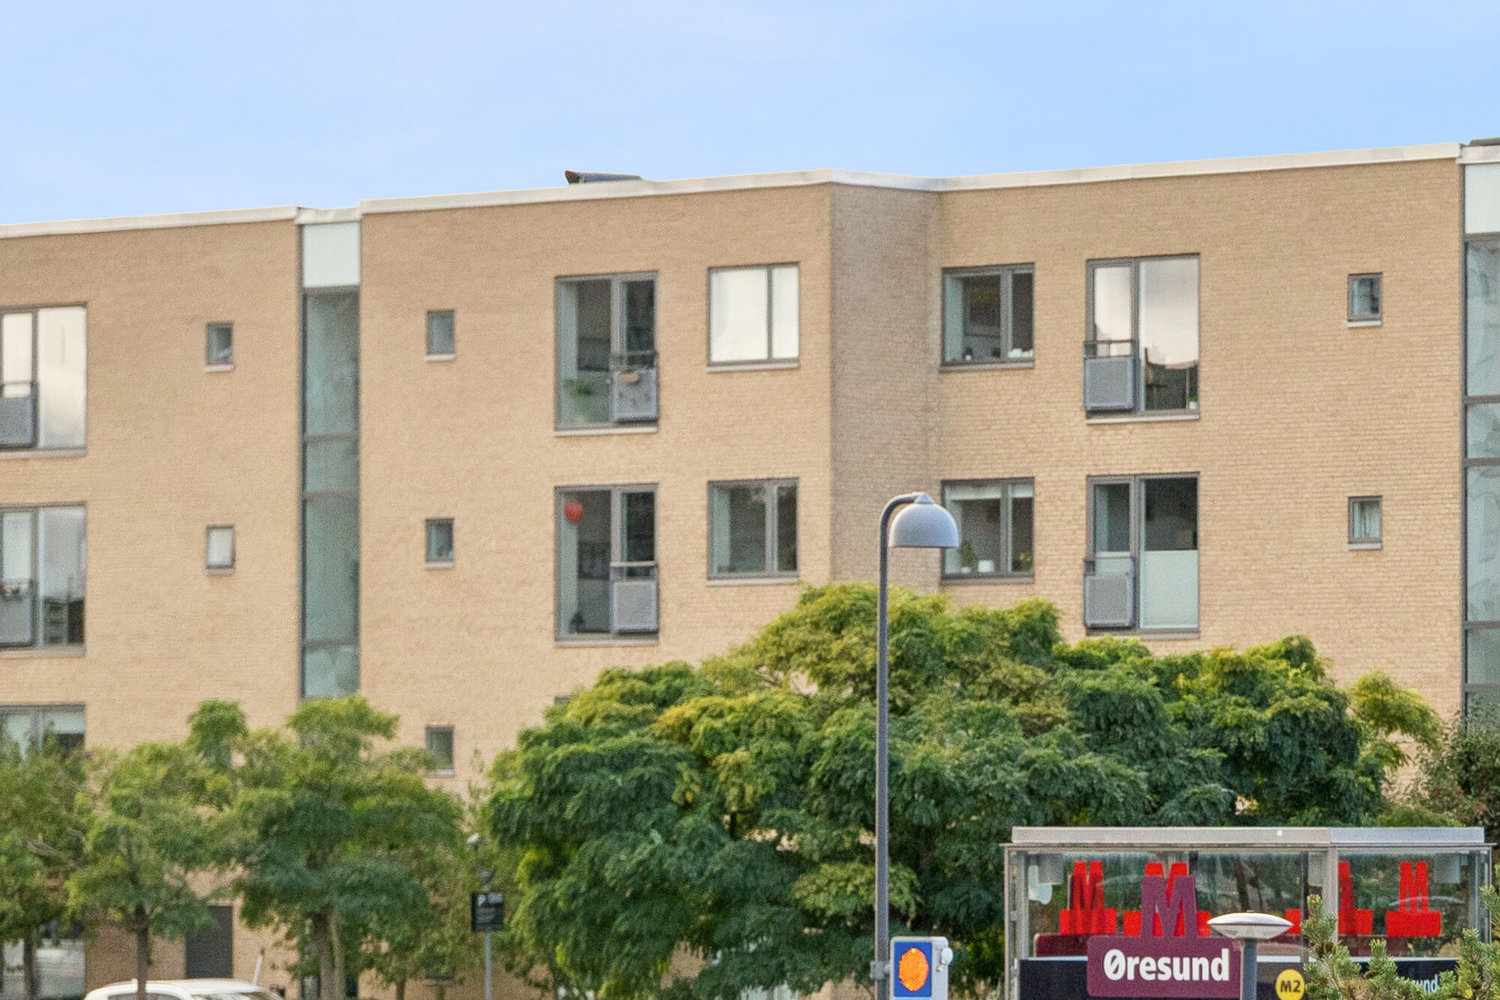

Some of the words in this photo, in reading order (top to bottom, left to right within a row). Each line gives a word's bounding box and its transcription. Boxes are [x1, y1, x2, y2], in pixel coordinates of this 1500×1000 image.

[1140, 876, 1200, 937] M
[1399, 861, 1429, 911] M
[1103, 948, 1230, 981] Øresund
[1279, 979, 1301, 993] M2
